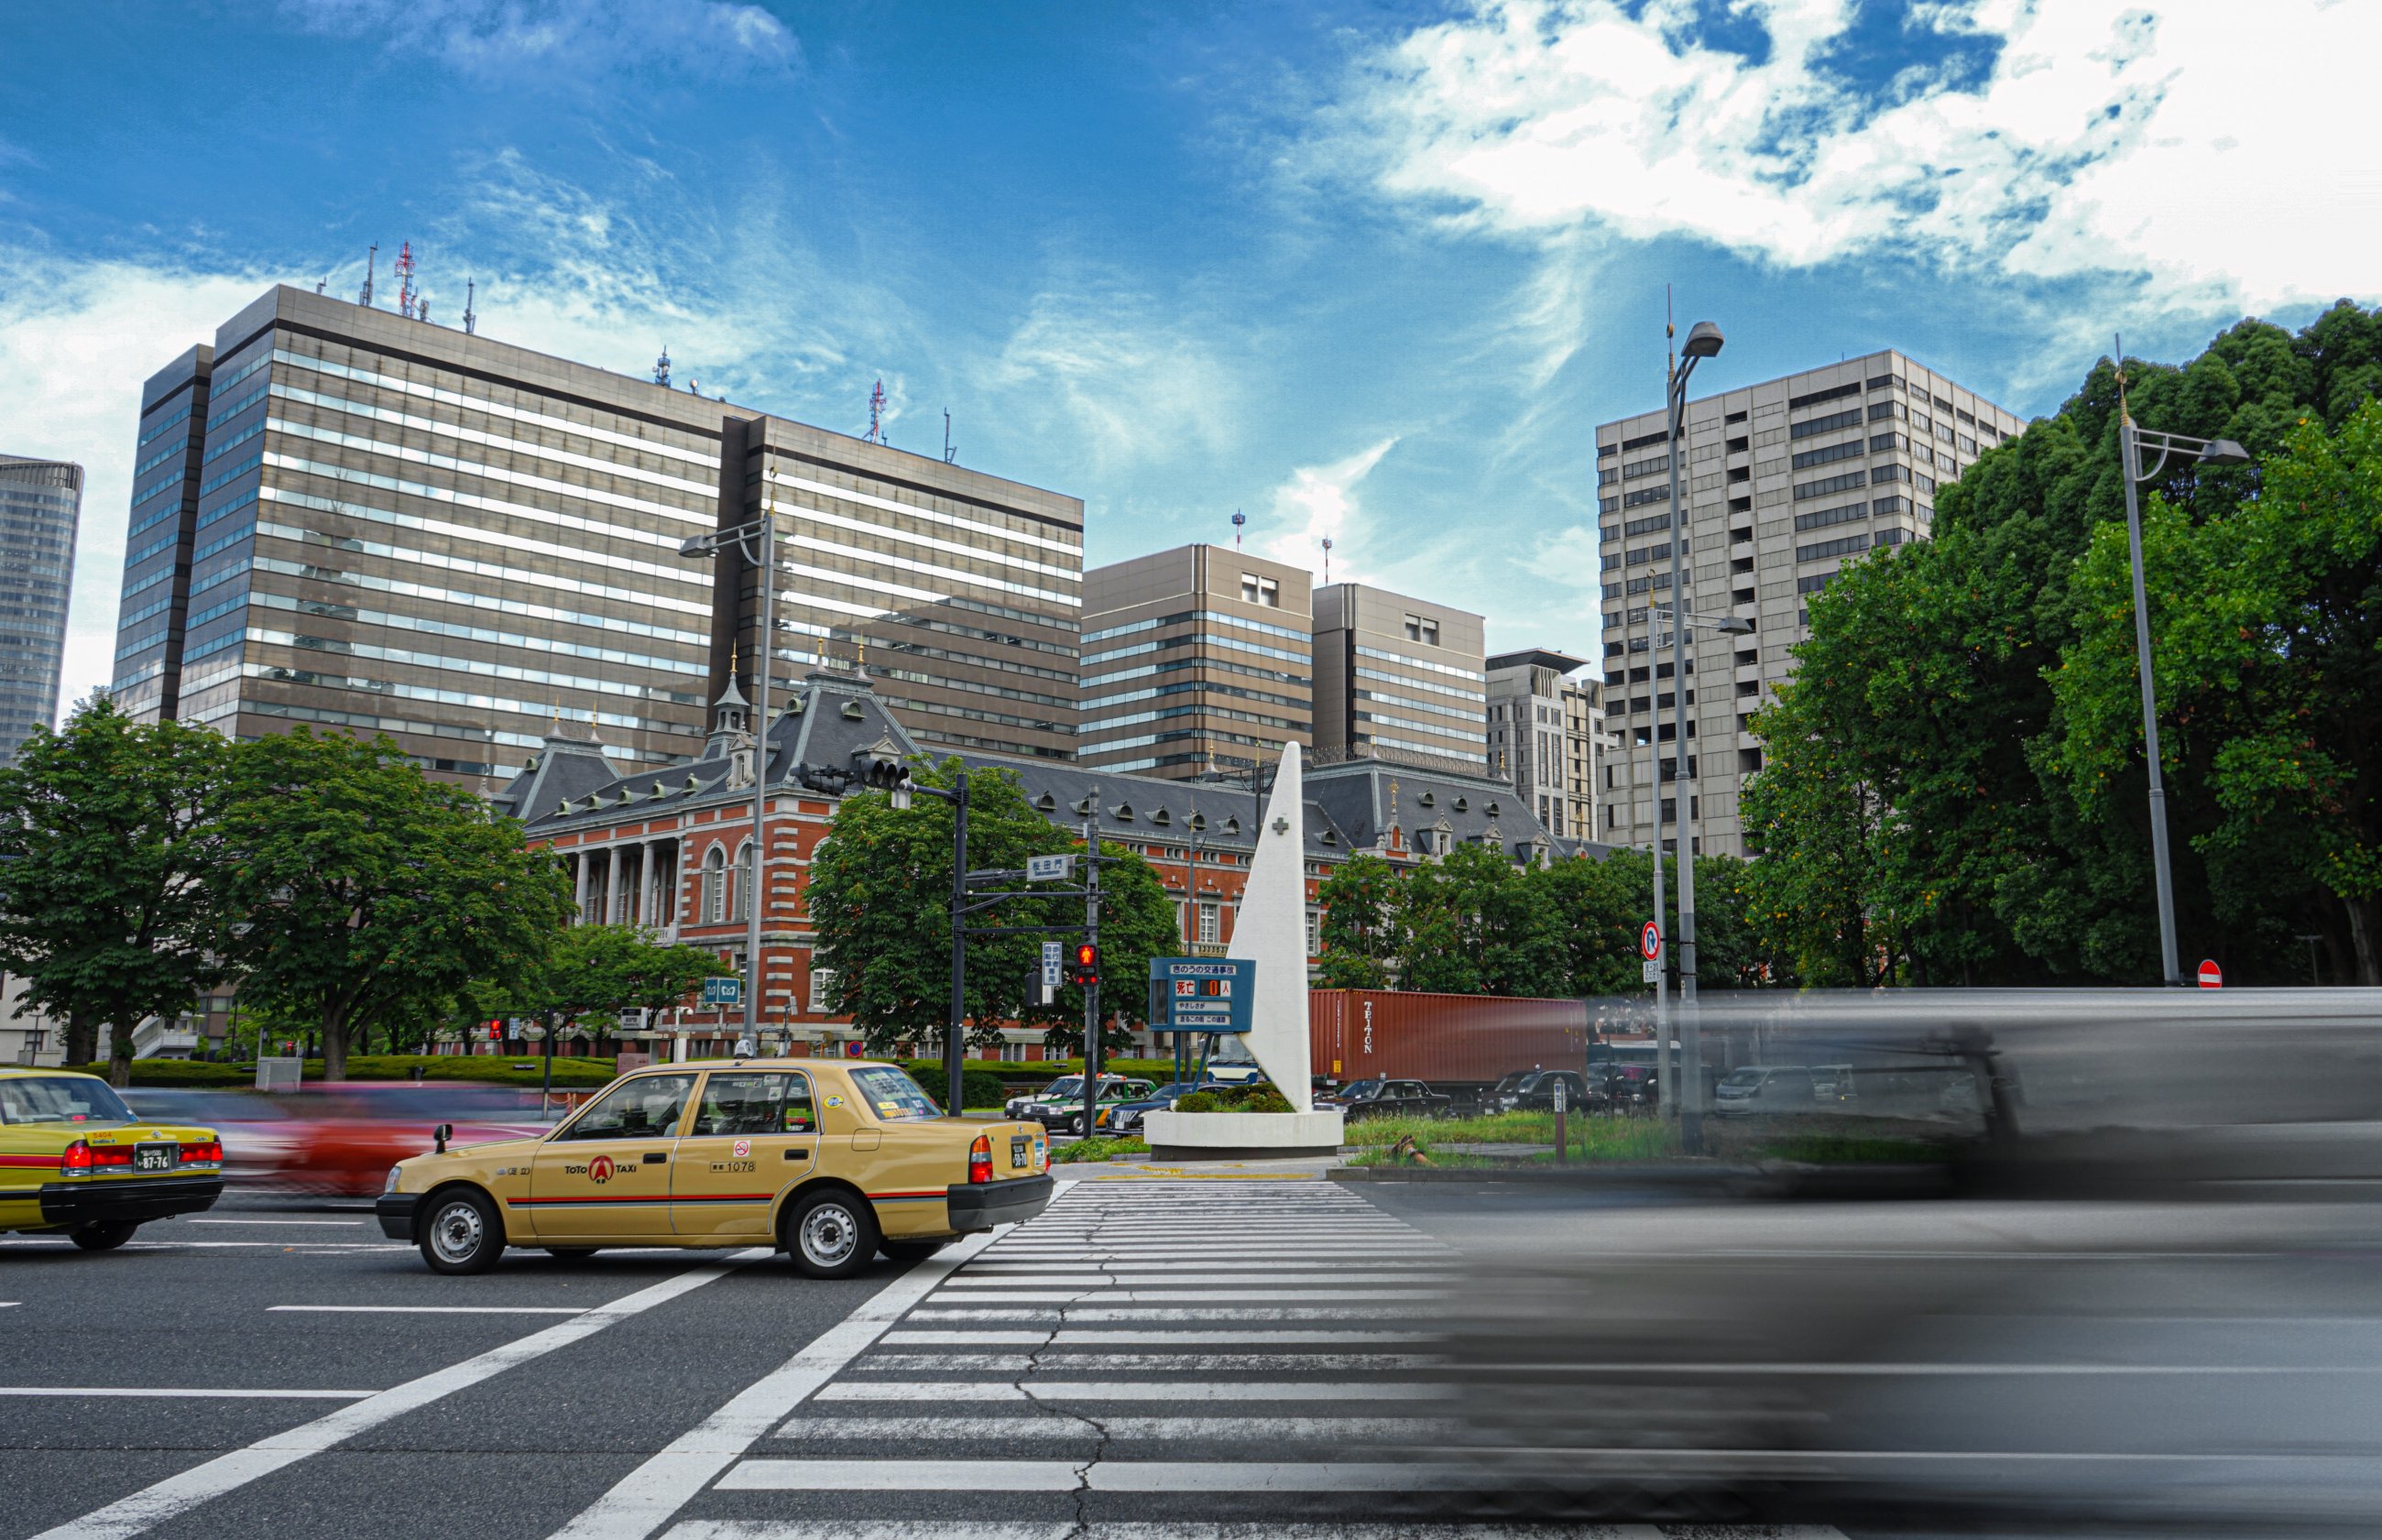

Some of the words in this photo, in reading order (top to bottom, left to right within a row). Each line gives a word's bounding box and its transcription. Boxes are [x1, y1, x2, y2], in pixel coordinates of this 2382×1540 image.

[1173, 966, 1234, 974] きのうの交通事故
[1176, 981, 1194, 994] 死亡
[1209, 980, 1218, 995] 0
[1222, 983, 1229, 992] 人
[1364, 1001, 1372, 1054] TRITON
[143, 1156, 169, 1169] 87-76
[727, 1162, 755, 1172] 1078
